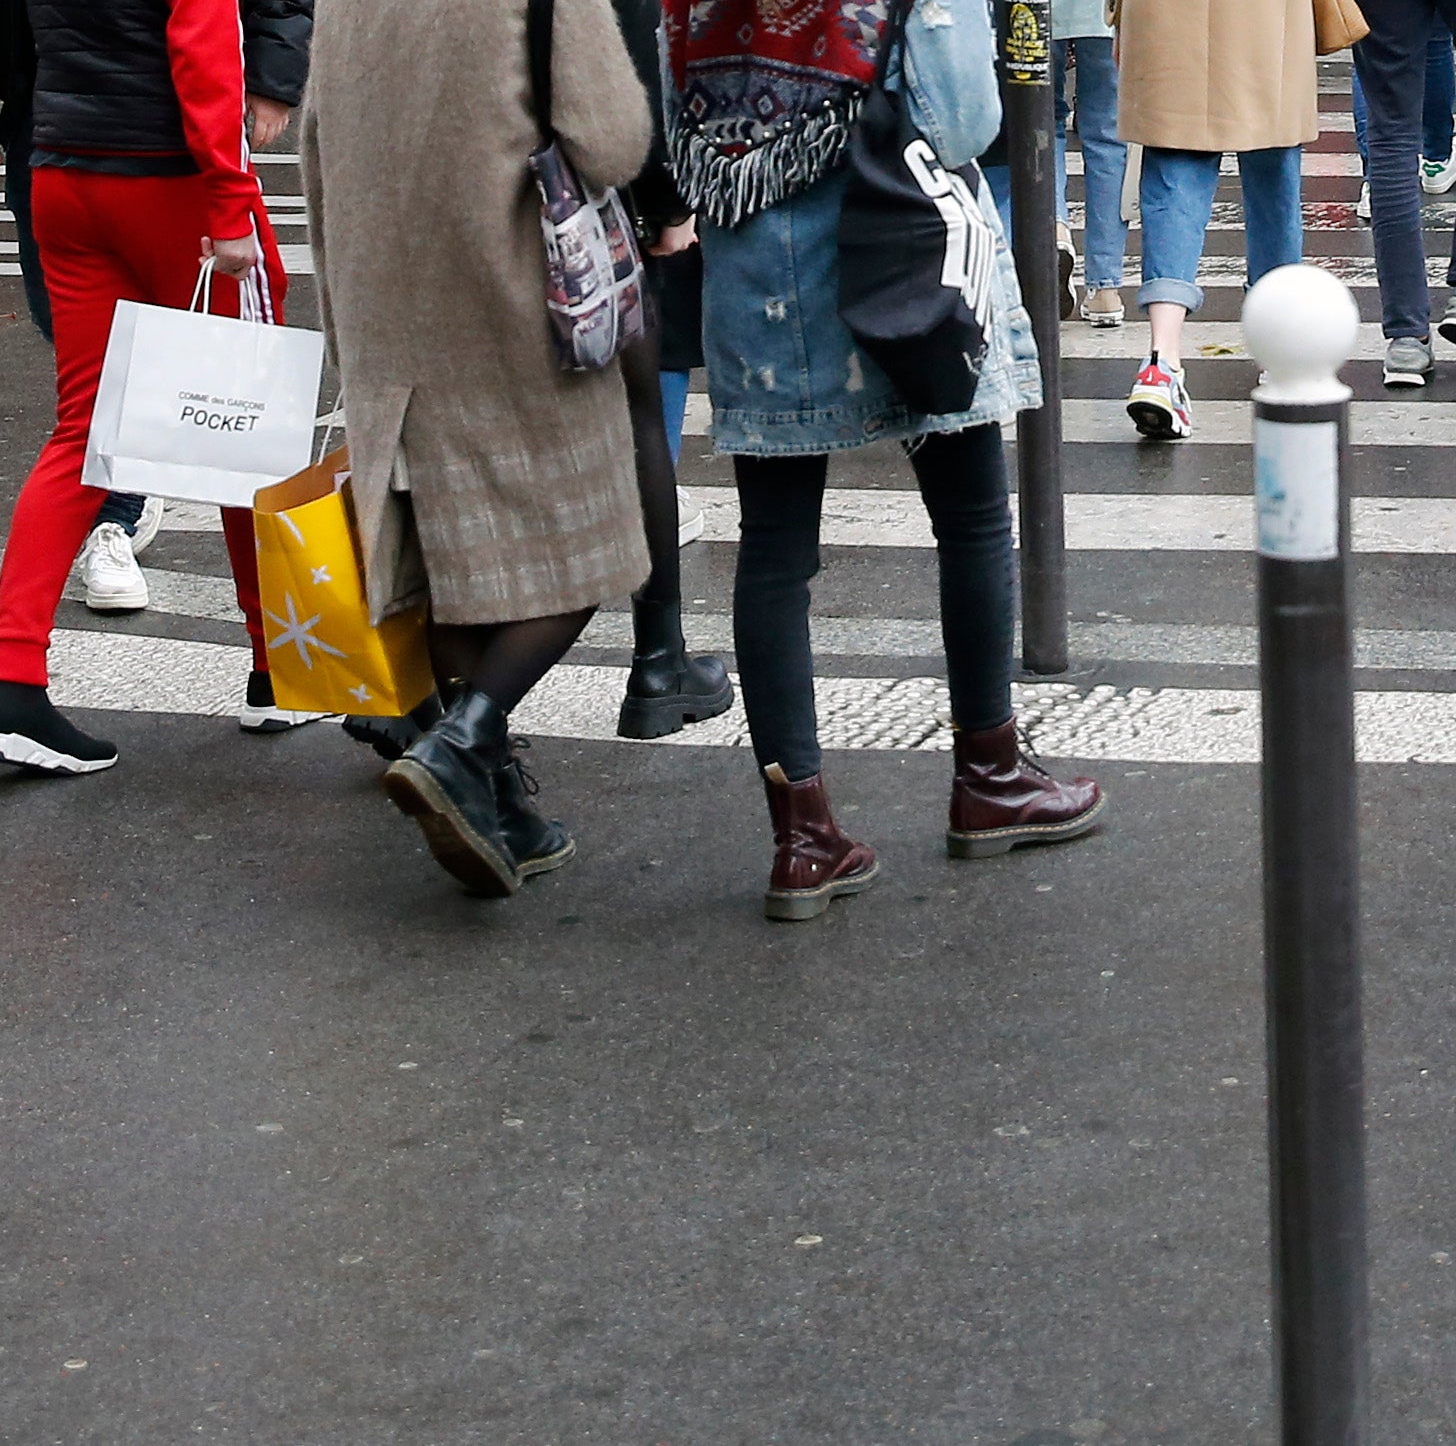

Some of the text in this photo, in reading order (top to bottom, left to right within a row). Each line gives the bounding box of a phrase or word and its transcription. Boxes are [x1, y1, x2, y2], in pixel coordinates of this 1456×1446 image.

[178, 391, 266, 412] COMME des GARÇONS
[180, 406, 259, 432] POCKET
